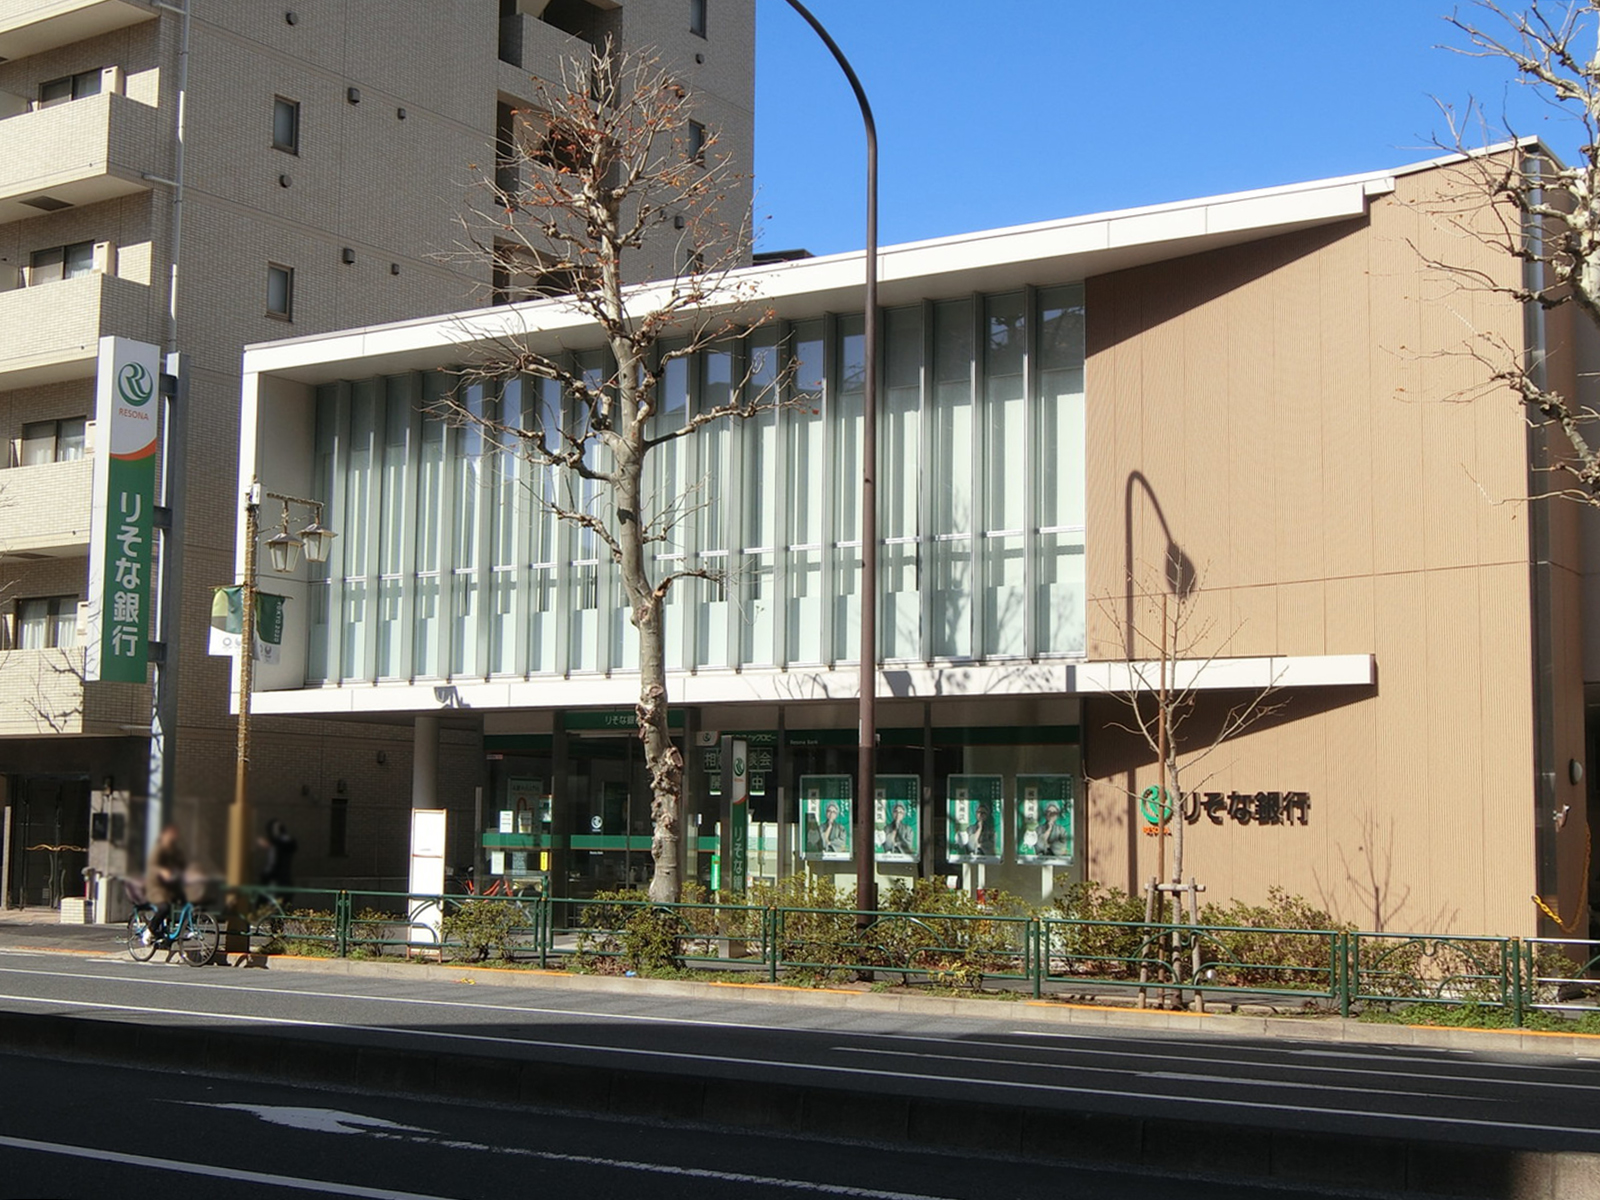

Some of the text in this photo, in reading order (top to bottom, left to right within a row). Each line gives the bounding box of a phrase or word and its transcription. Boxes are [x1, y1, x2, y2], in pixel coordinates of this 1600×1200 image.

[118, 407, 149, 421] RESONA
[111, 491, 143, 658] りそな銀行
[604, 715, 635, 726] りそな銀
[1181, 791, 1311, 826] りそな銀行
[1142, 826, 1170, 834] RESOA
[733, 826, 743, 893] りそな銀
